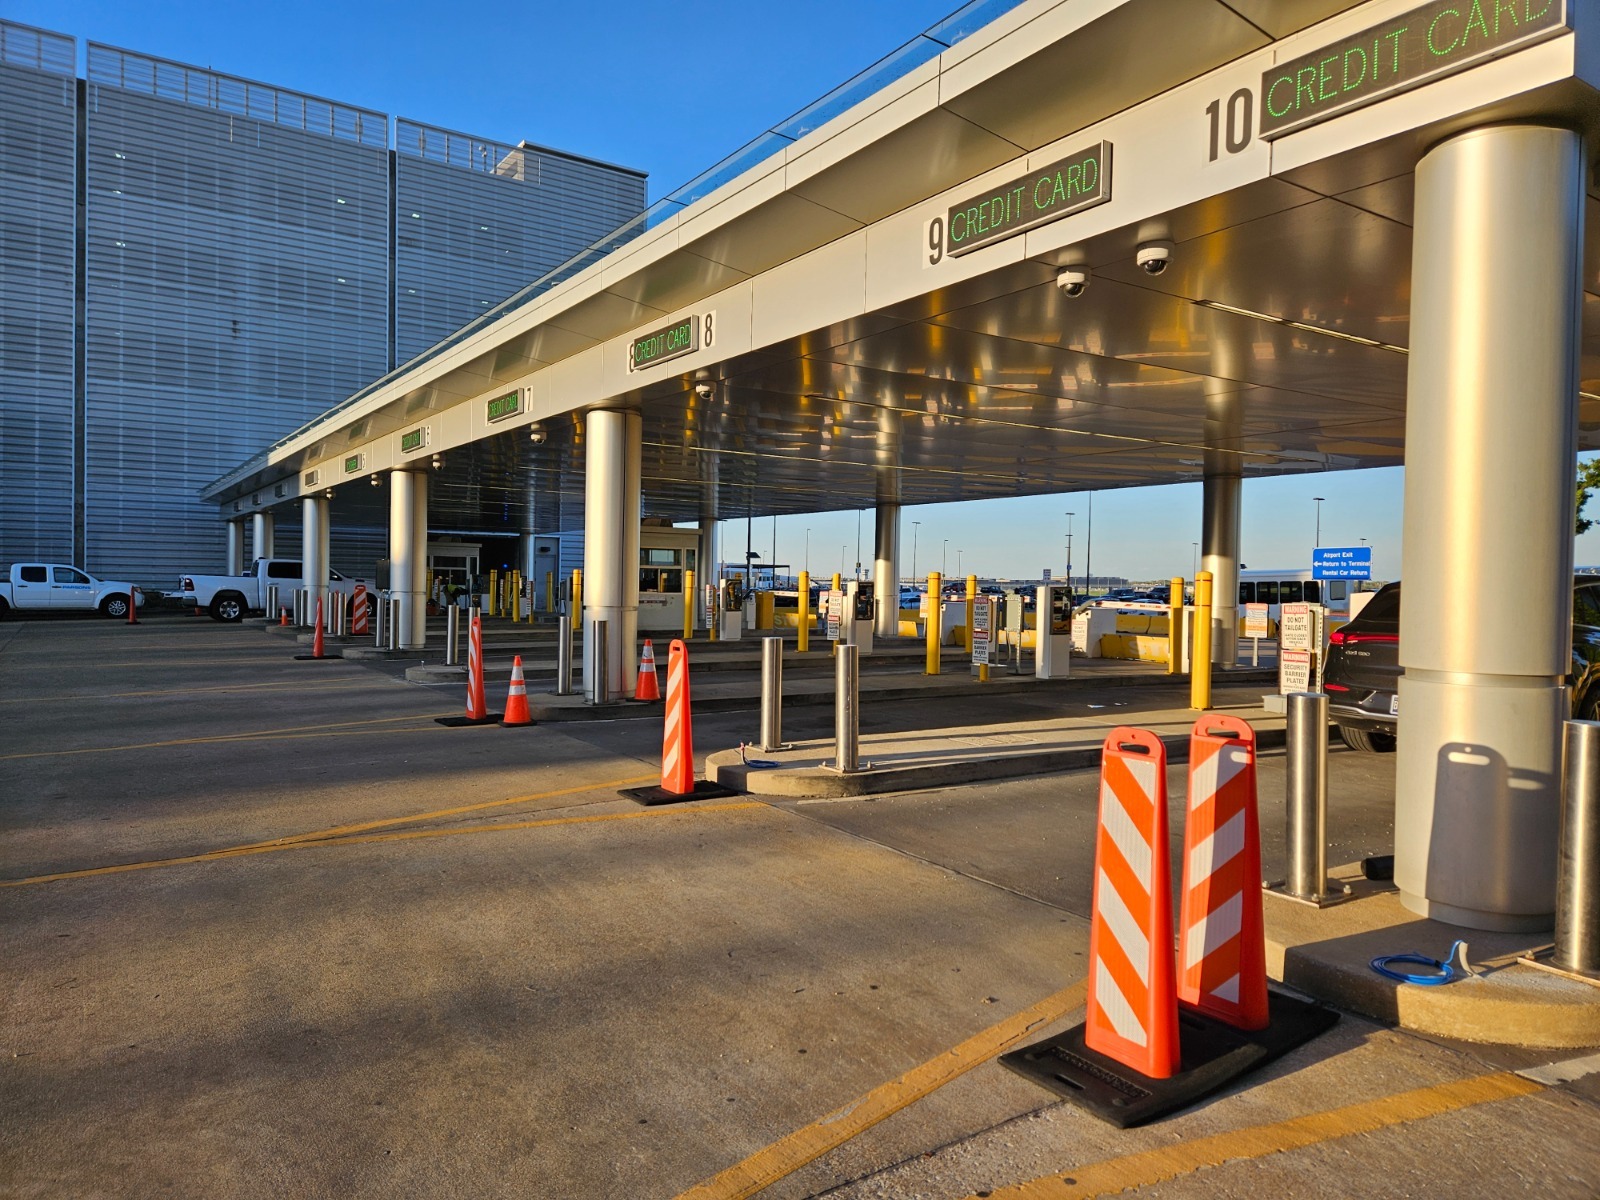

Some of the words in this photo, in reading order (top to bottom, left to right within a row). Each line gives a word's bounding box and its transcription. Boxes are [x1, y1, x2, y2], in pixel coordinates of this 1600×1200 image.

[1267, 28, 1408, 117] CREDIT
[1205, 87, 1253, 162] 10
[951, 186, 1026, 242] CREDIT
[1034, 158, 1098, 209] CARD
[929, 217, 944, 266] 9
[635, 334, 665, 362] CREDIT
[667, 324, 691, 351] CARD
[704, 313, 713, 348] 8
[489, 399, 505, 418] CREDIT
[506, 394, 519, 412] CARD
[526, 387, 531, 412] 7
[1284, 605, 1308, 614] WARNING
